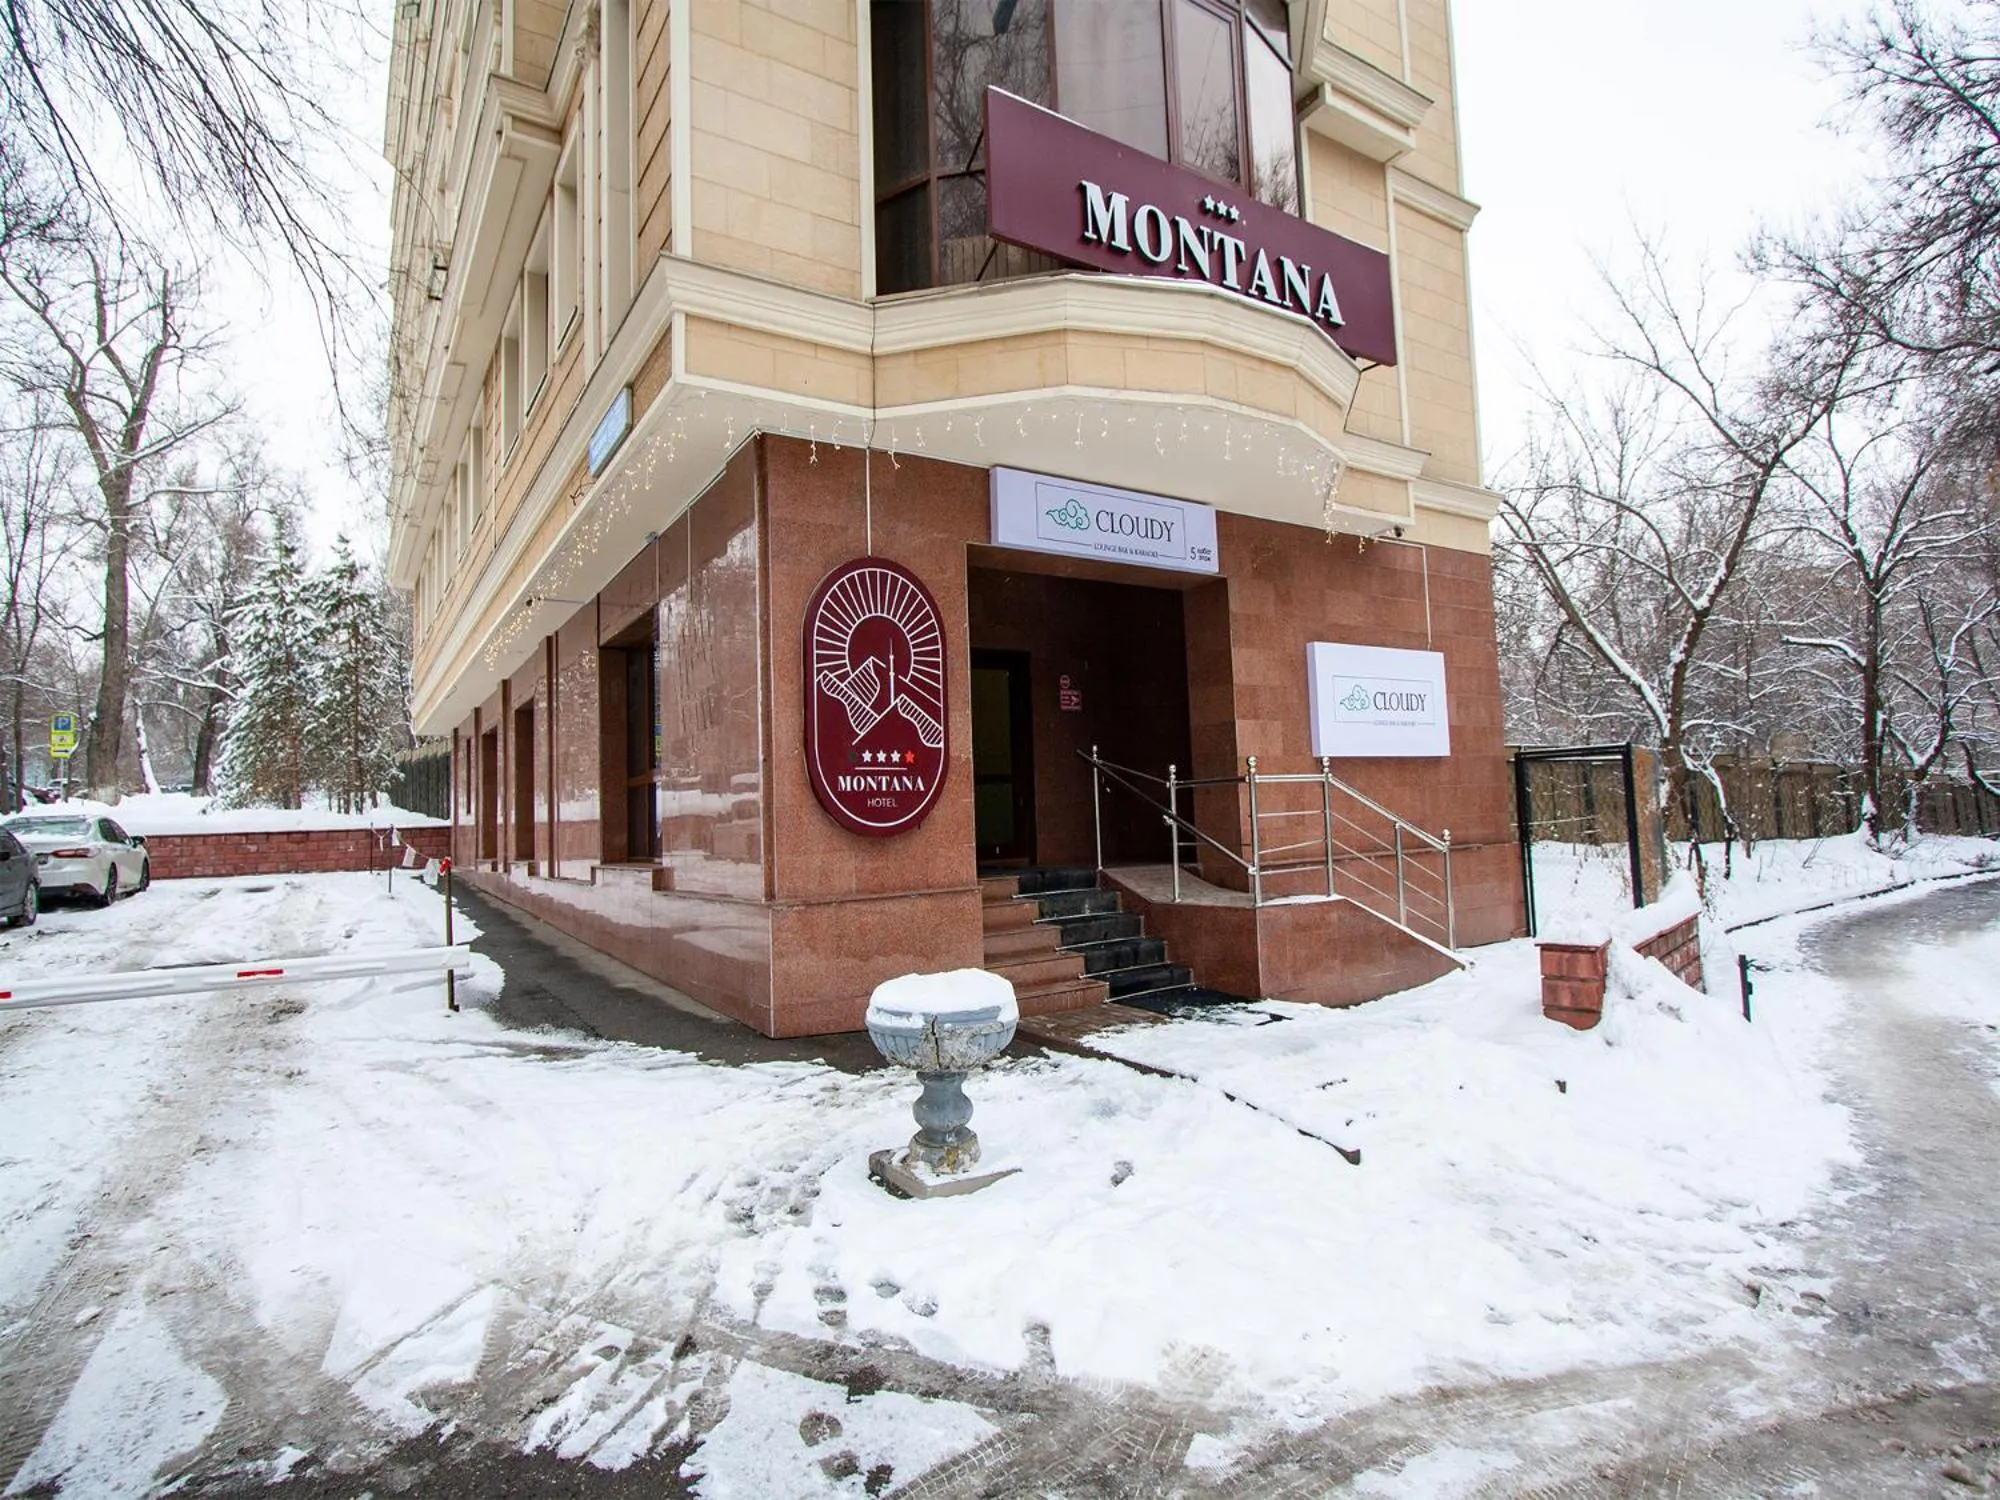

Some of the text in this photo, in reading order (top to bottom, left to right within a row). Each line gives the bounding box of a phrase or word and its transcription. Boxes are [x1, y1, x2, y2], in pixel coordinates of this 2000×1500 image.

[1080, 180, 1345, 327] MONTANA
[1096, 510, 1174, 542] CLOUDY
[1190, 546, 1196, 560] 5
[1373, 691, 1427, 712] CLOUDY
[58, 716, 69, 729] P
[838, 775, 925, 791] MONTANA
[867, 798, 898, 808] HOTEL
